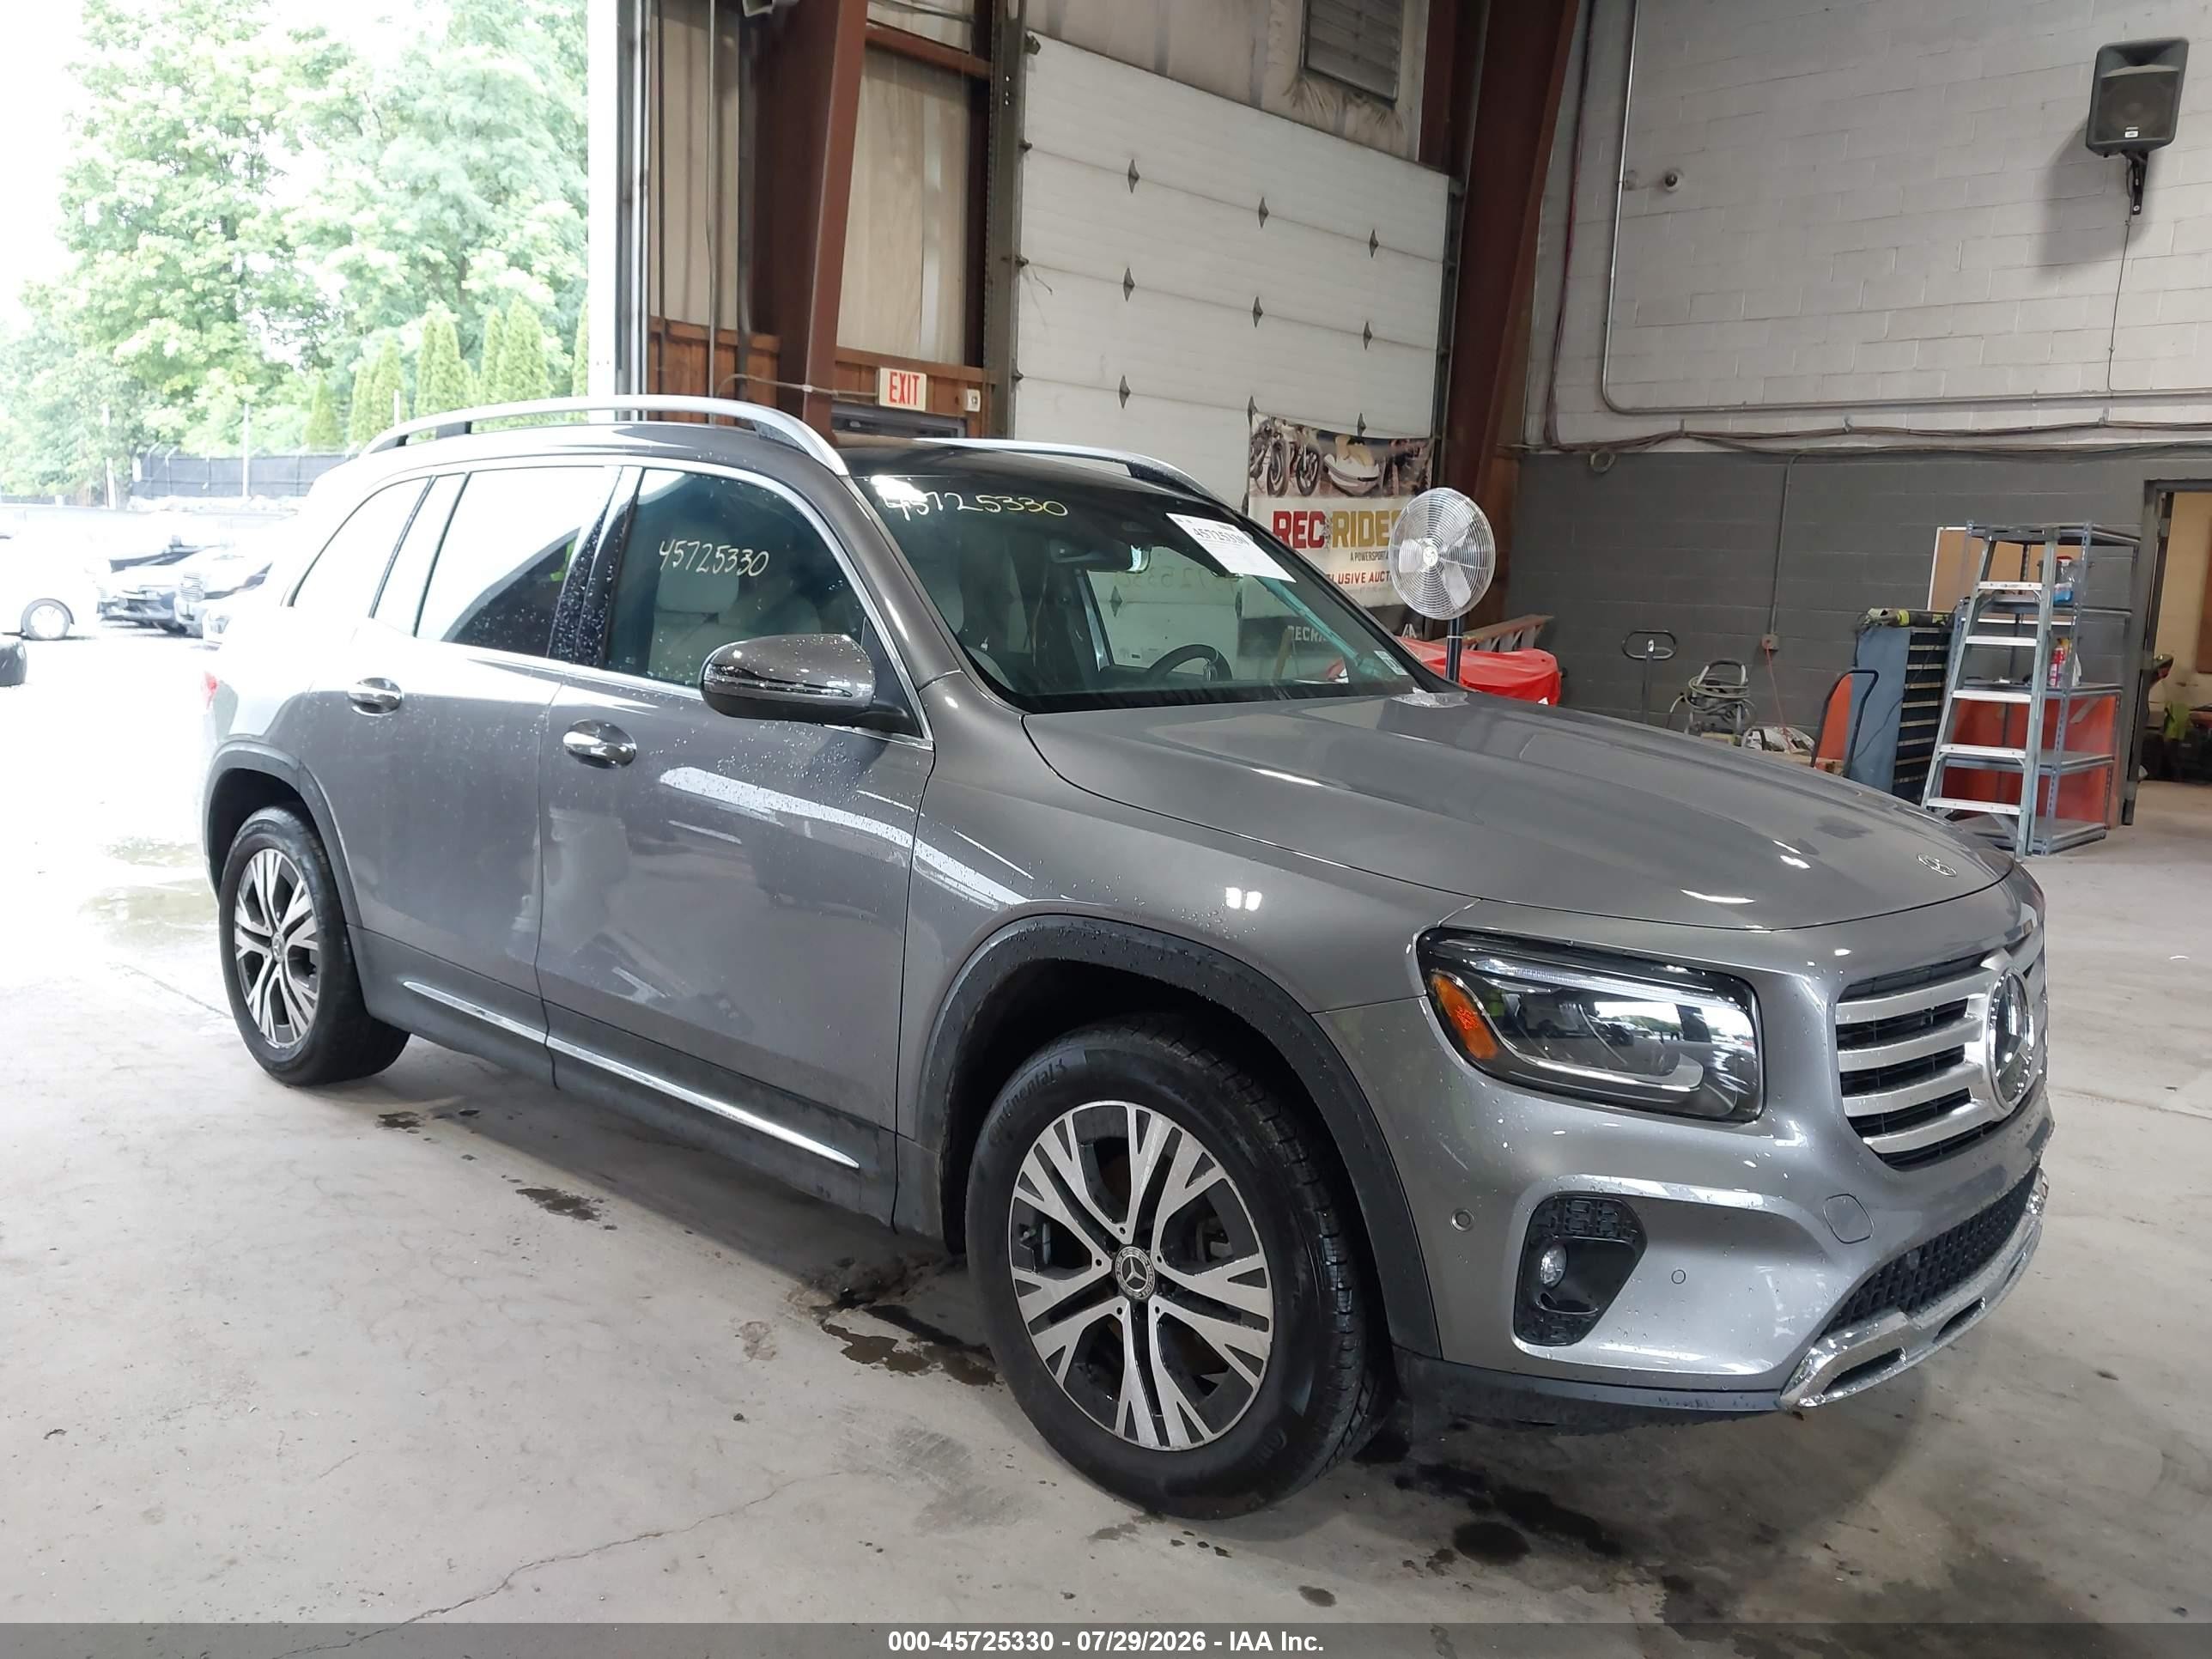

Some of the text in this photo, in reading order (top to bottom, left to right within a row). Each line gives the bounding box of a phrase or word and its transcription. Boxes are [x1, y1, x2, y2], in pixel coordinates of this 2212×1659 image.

[889, 371, 920, 405] EXIT
[1273, 511, 1326, 549] REC
[659, 538, 769, 576] 45725330
